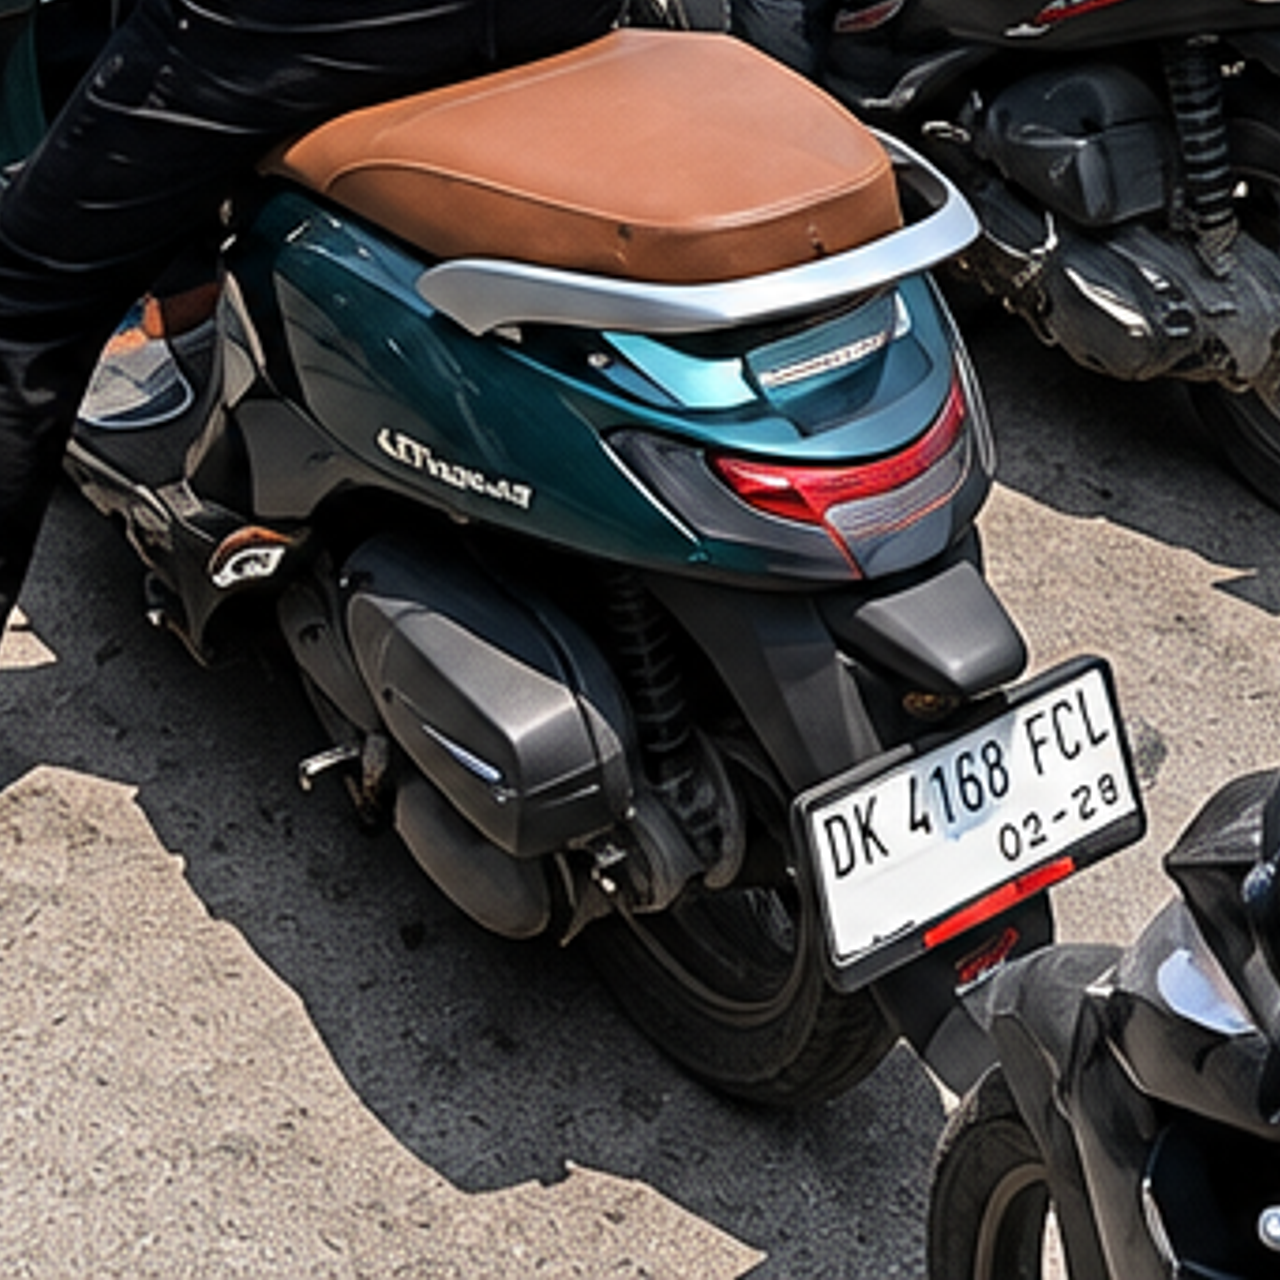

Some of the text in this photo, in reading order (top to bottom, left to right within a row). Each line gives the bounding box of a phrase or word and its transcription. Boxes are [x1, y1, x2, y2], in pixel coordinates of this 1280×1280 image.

[823, 689, 1110, 880] DK 4168 FCL
